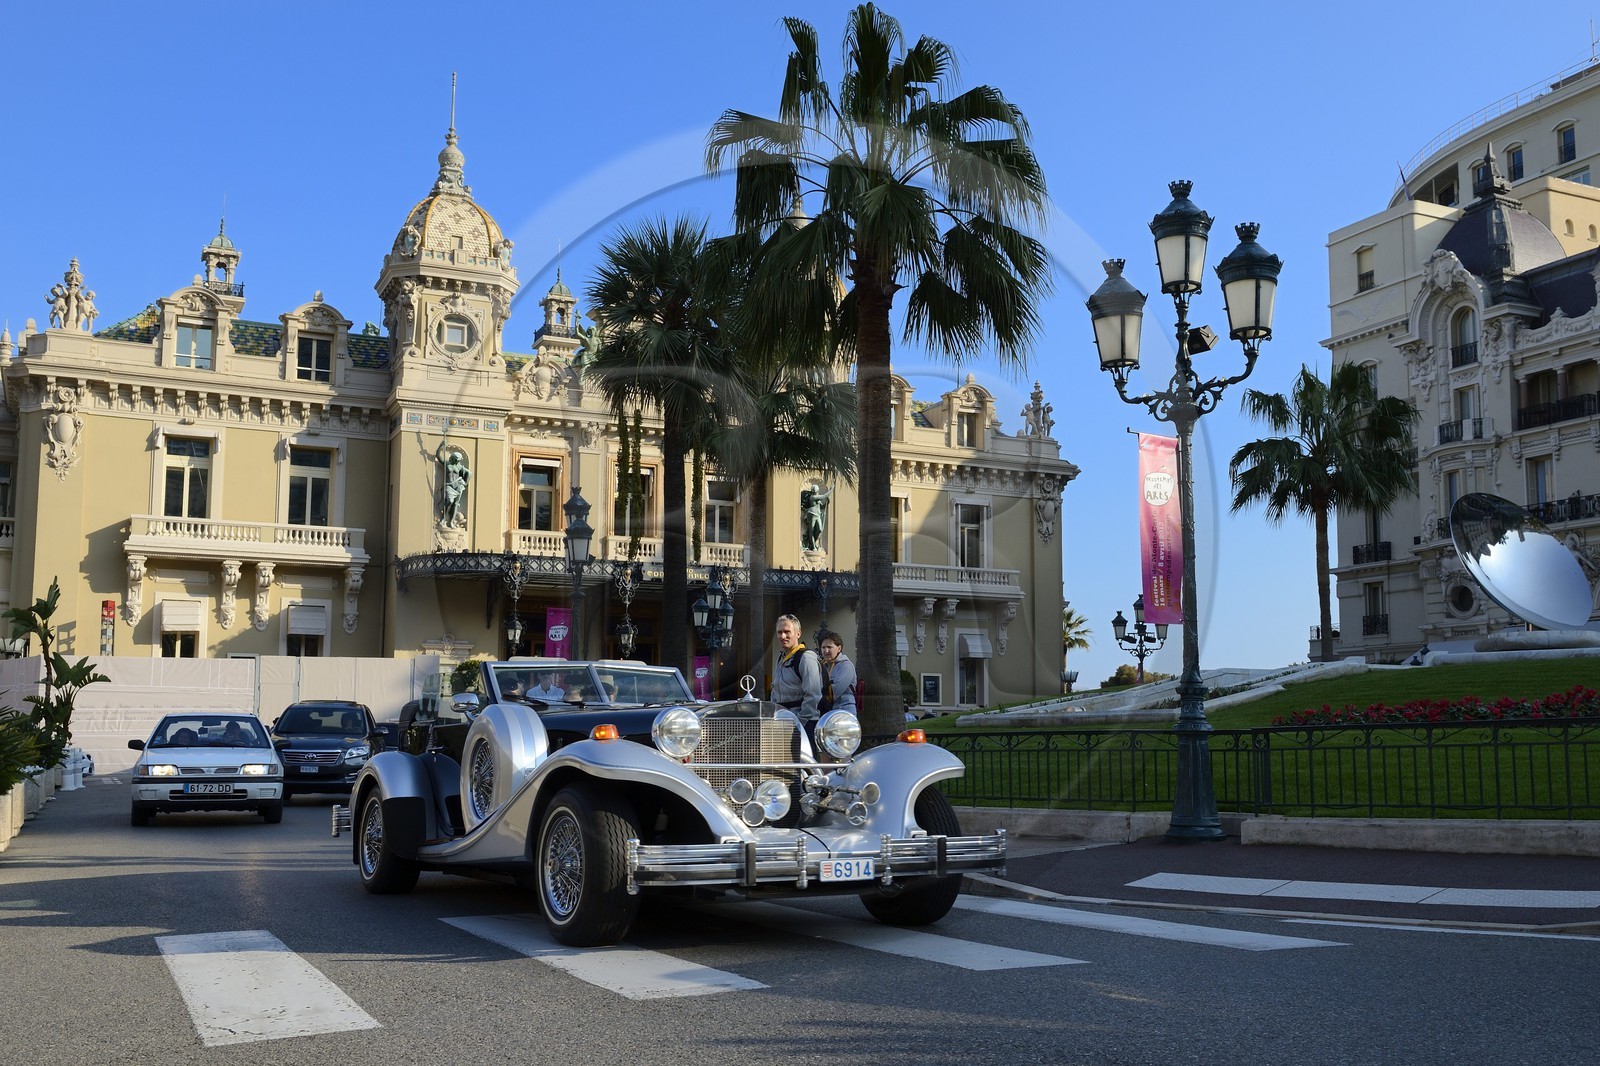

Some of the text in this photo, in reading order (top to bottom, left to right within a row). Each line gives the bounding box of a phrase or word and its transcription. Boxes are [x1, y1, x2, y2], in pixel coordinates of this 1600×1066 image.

[1165, 514, 1173, 608] printempsdesarts.com
[1159, 597, 1166, 607] 16
[834, 861, 872, 878] 6914
